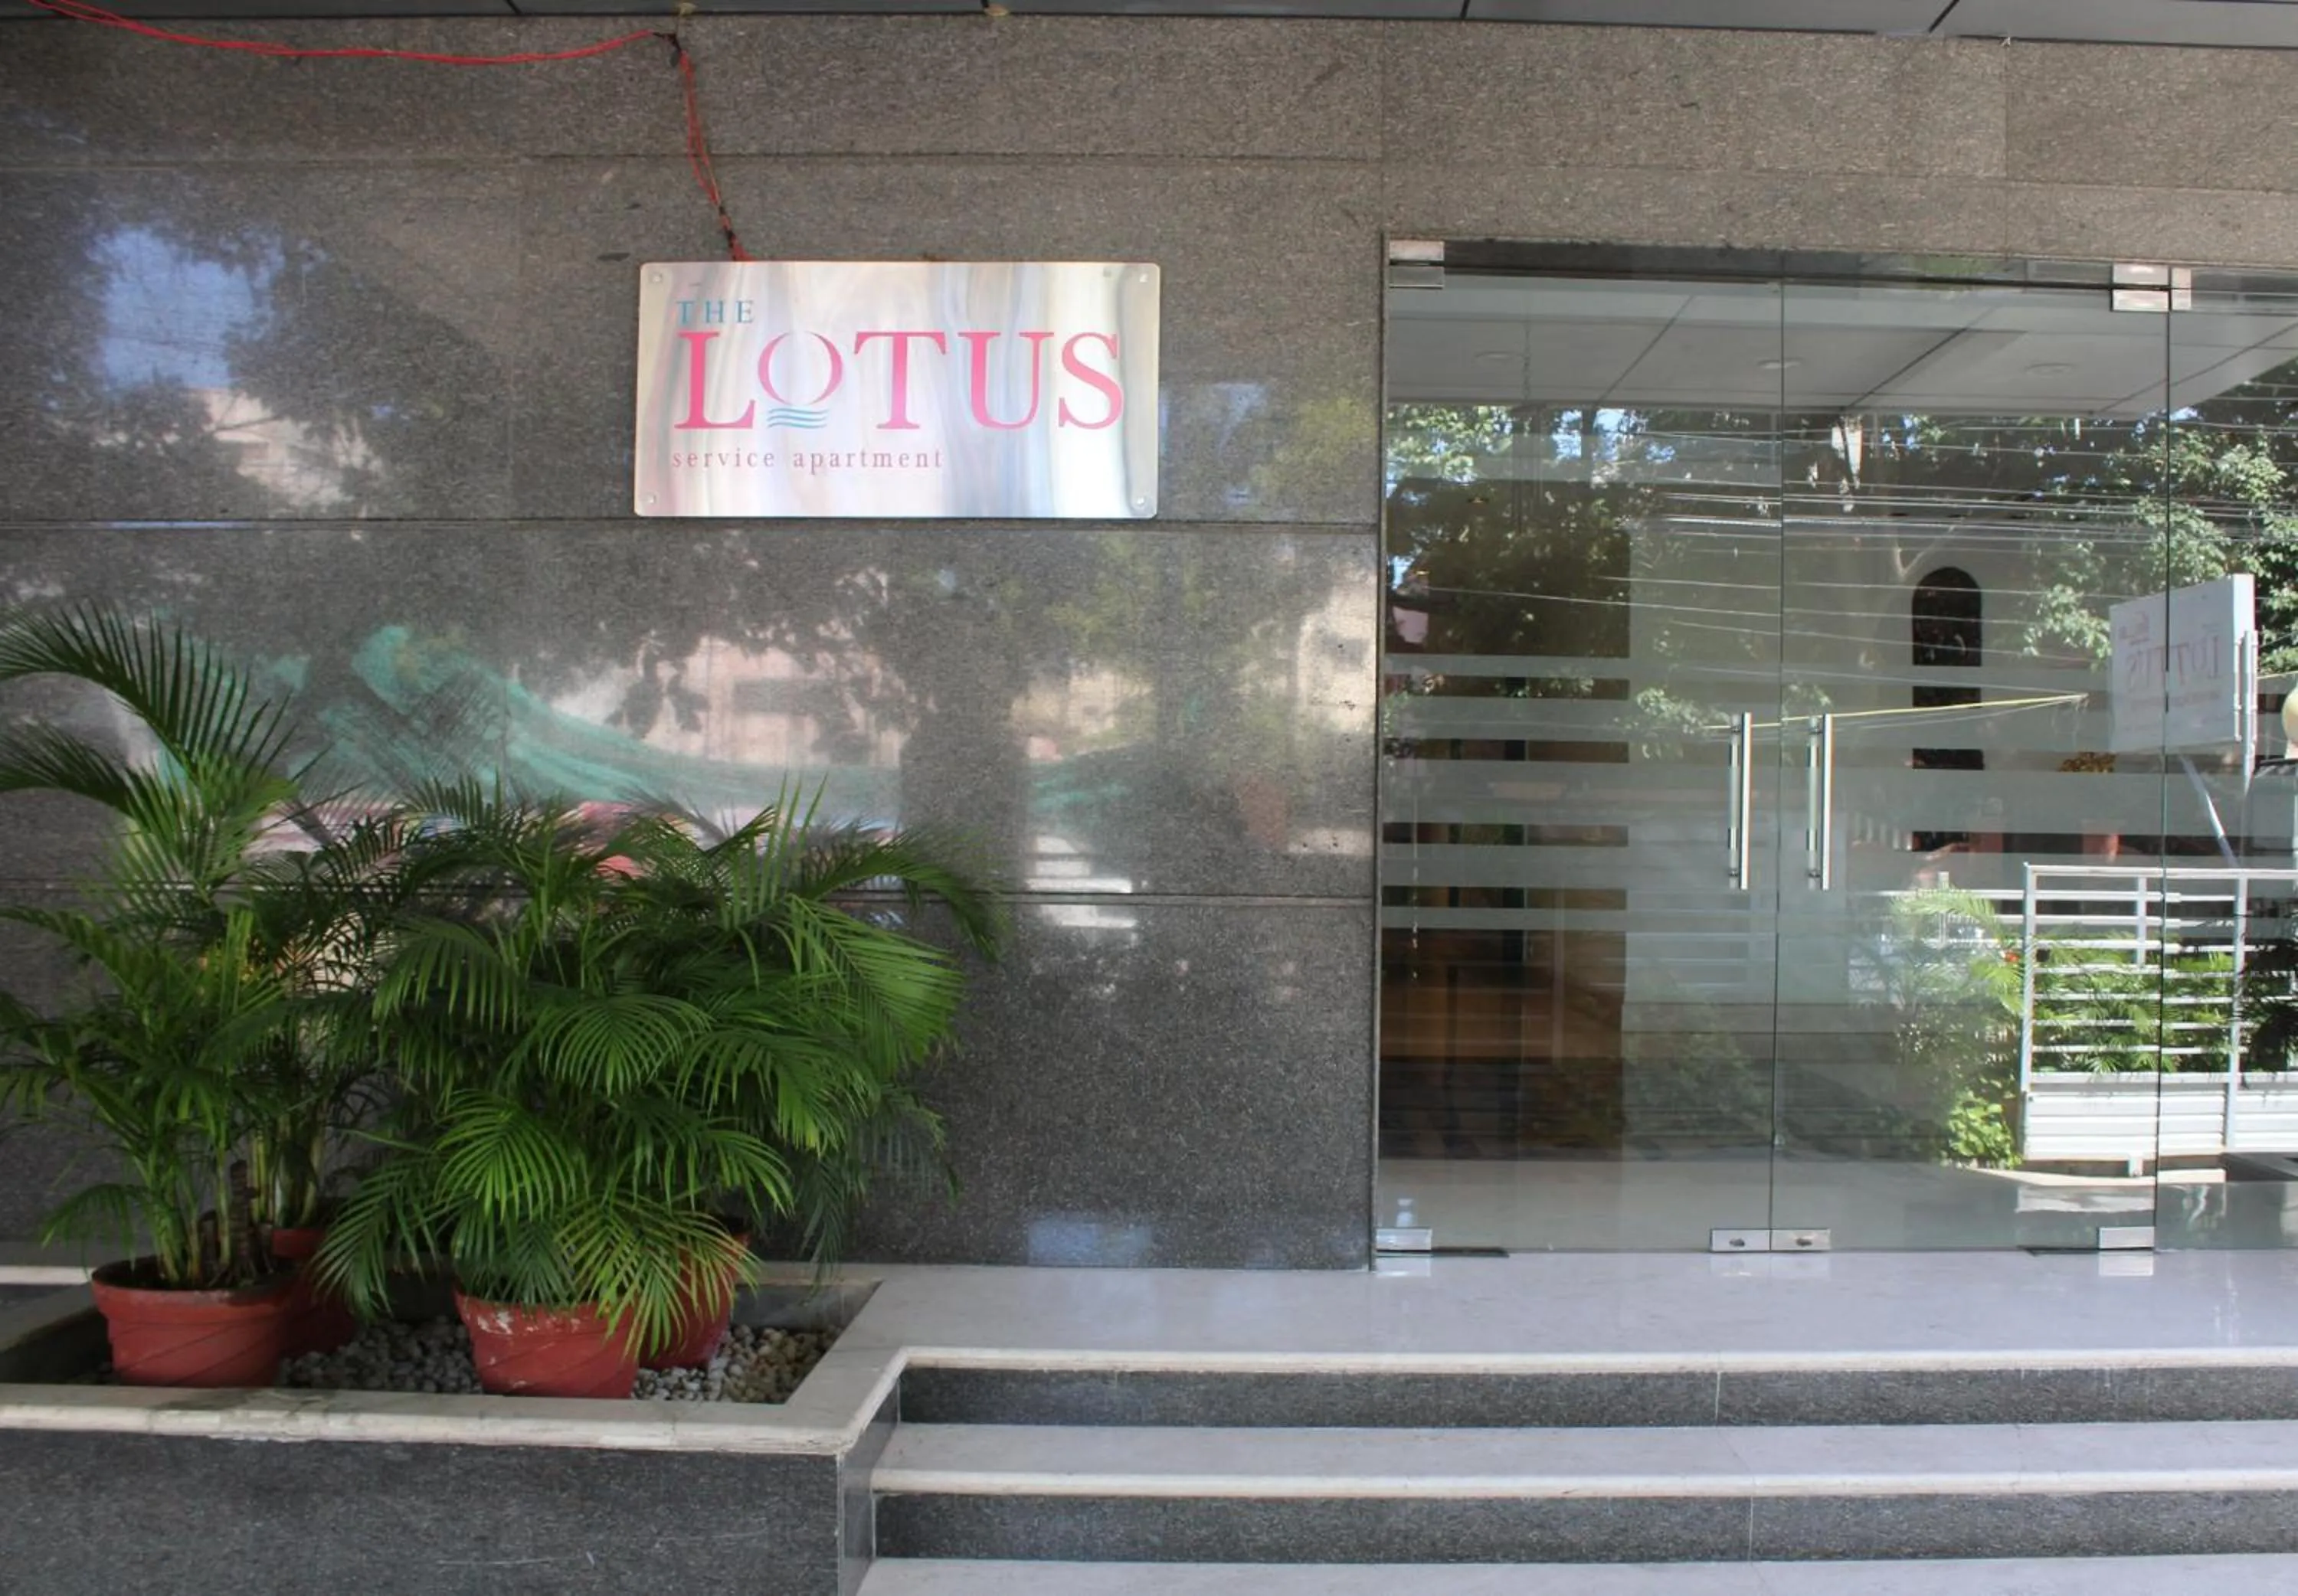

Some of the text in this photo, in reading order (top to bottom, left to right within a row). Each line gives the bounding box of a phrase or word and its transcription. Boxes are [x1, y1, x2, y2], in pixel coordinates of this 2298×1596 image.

[676, 299, 754, 324] THE
[673, 331, 1124, 430] LOTUS
[673, 447, 943, 475] service apartment
